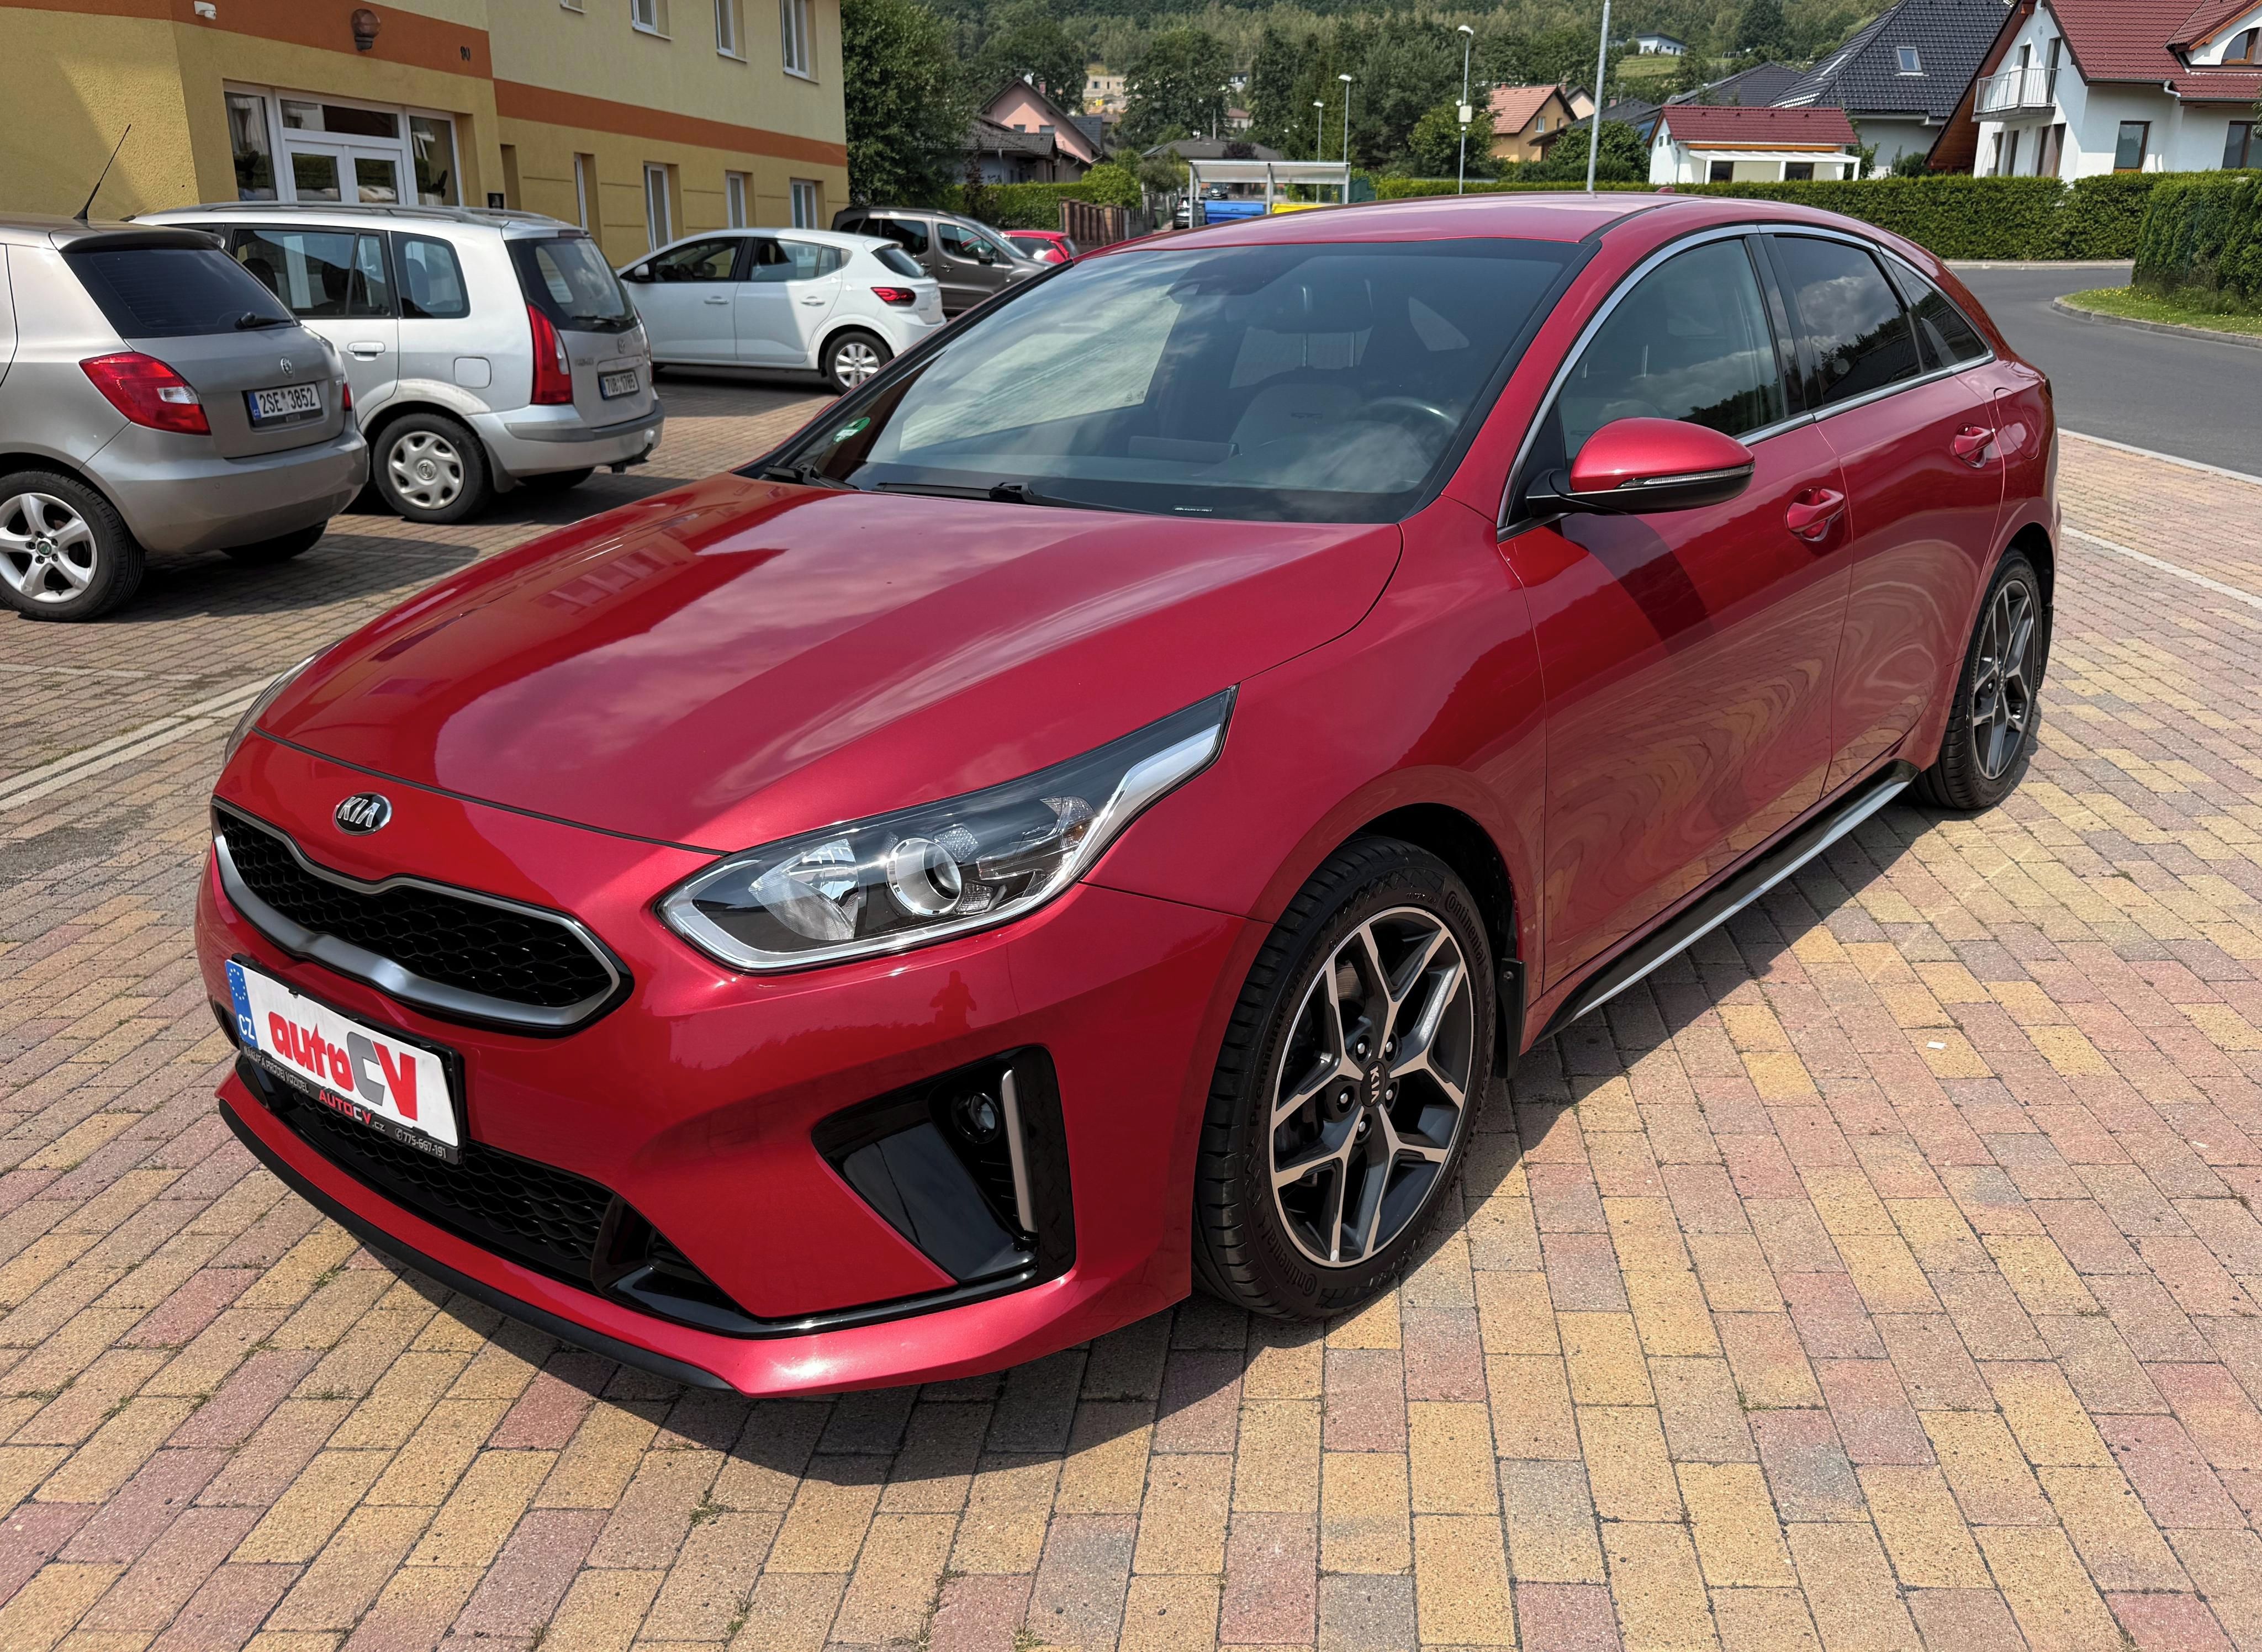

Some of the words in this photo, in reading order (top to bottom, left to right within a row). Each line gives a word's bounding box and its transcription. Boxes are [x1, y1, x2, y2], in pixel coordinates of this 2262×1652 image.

[260, 392, 283, 414] 2SE
[288, 388, 316, 410] 3852
[337, 796, 380, 828] KIA
[1445, 891, 1486, 966] Continental
[239, 1013, 255, 1040] CZ
[267, 1060, 285, 1082] PRODEJ
[286, 1071, 309, 1093] VOZIDEL
[268, 1012, 417, 1121] autoCV
[1370, 1065, 1380, 1103] KIA
[404, 1132, 446, 1158] 775-667-191
[1261, 1224, 1318, 1297] Continental
